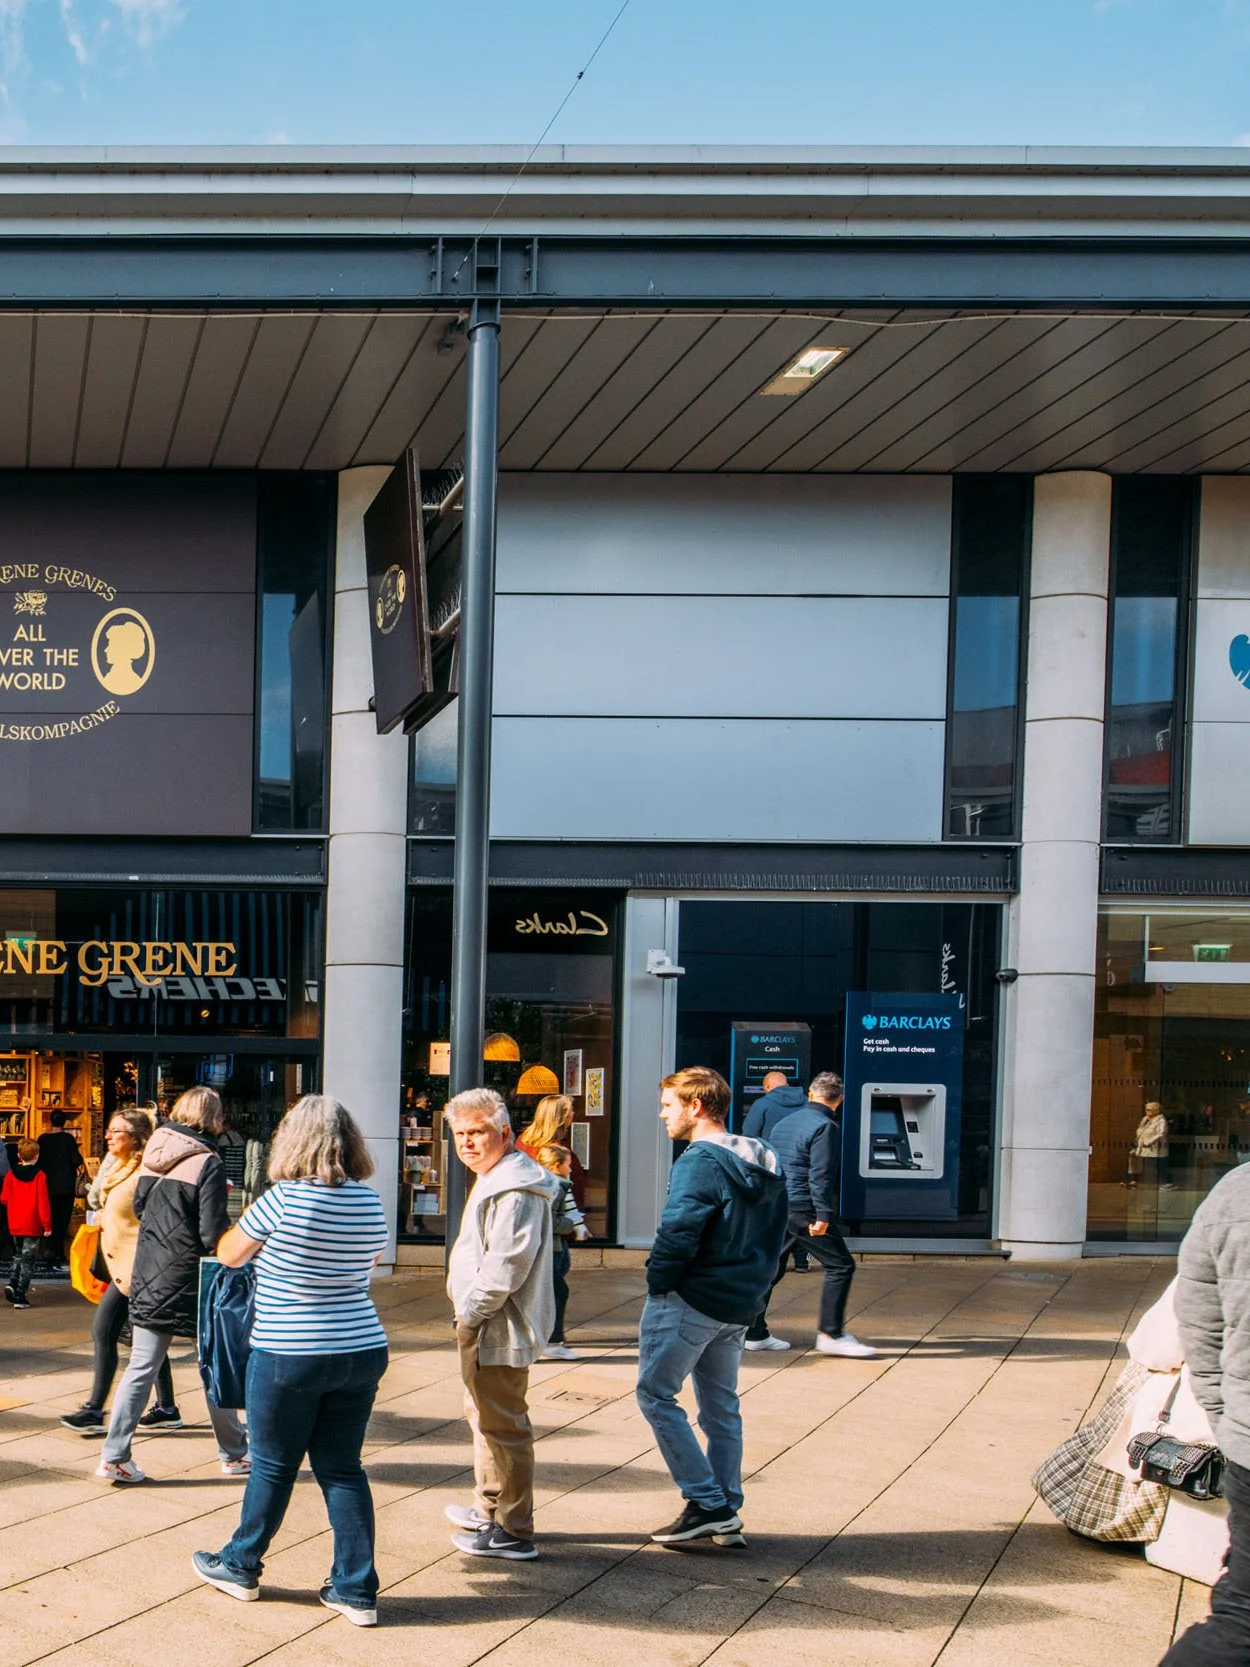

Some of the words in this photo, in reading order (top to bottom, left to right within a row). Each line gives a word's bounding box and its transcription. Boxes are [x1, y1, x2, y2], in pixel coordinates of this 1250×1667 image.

[45, 565, 117, 602] GRENES
[13, 624, 46, 642] ALL
[43, 648, 78, 666] THE
[77, 940, 237, 986] GRENE
[879, 1016, 951, 1030] BARCLAYS
[863, 1045, 874, 1054] Pay
[911, 1046, 935, 1054] cheques
